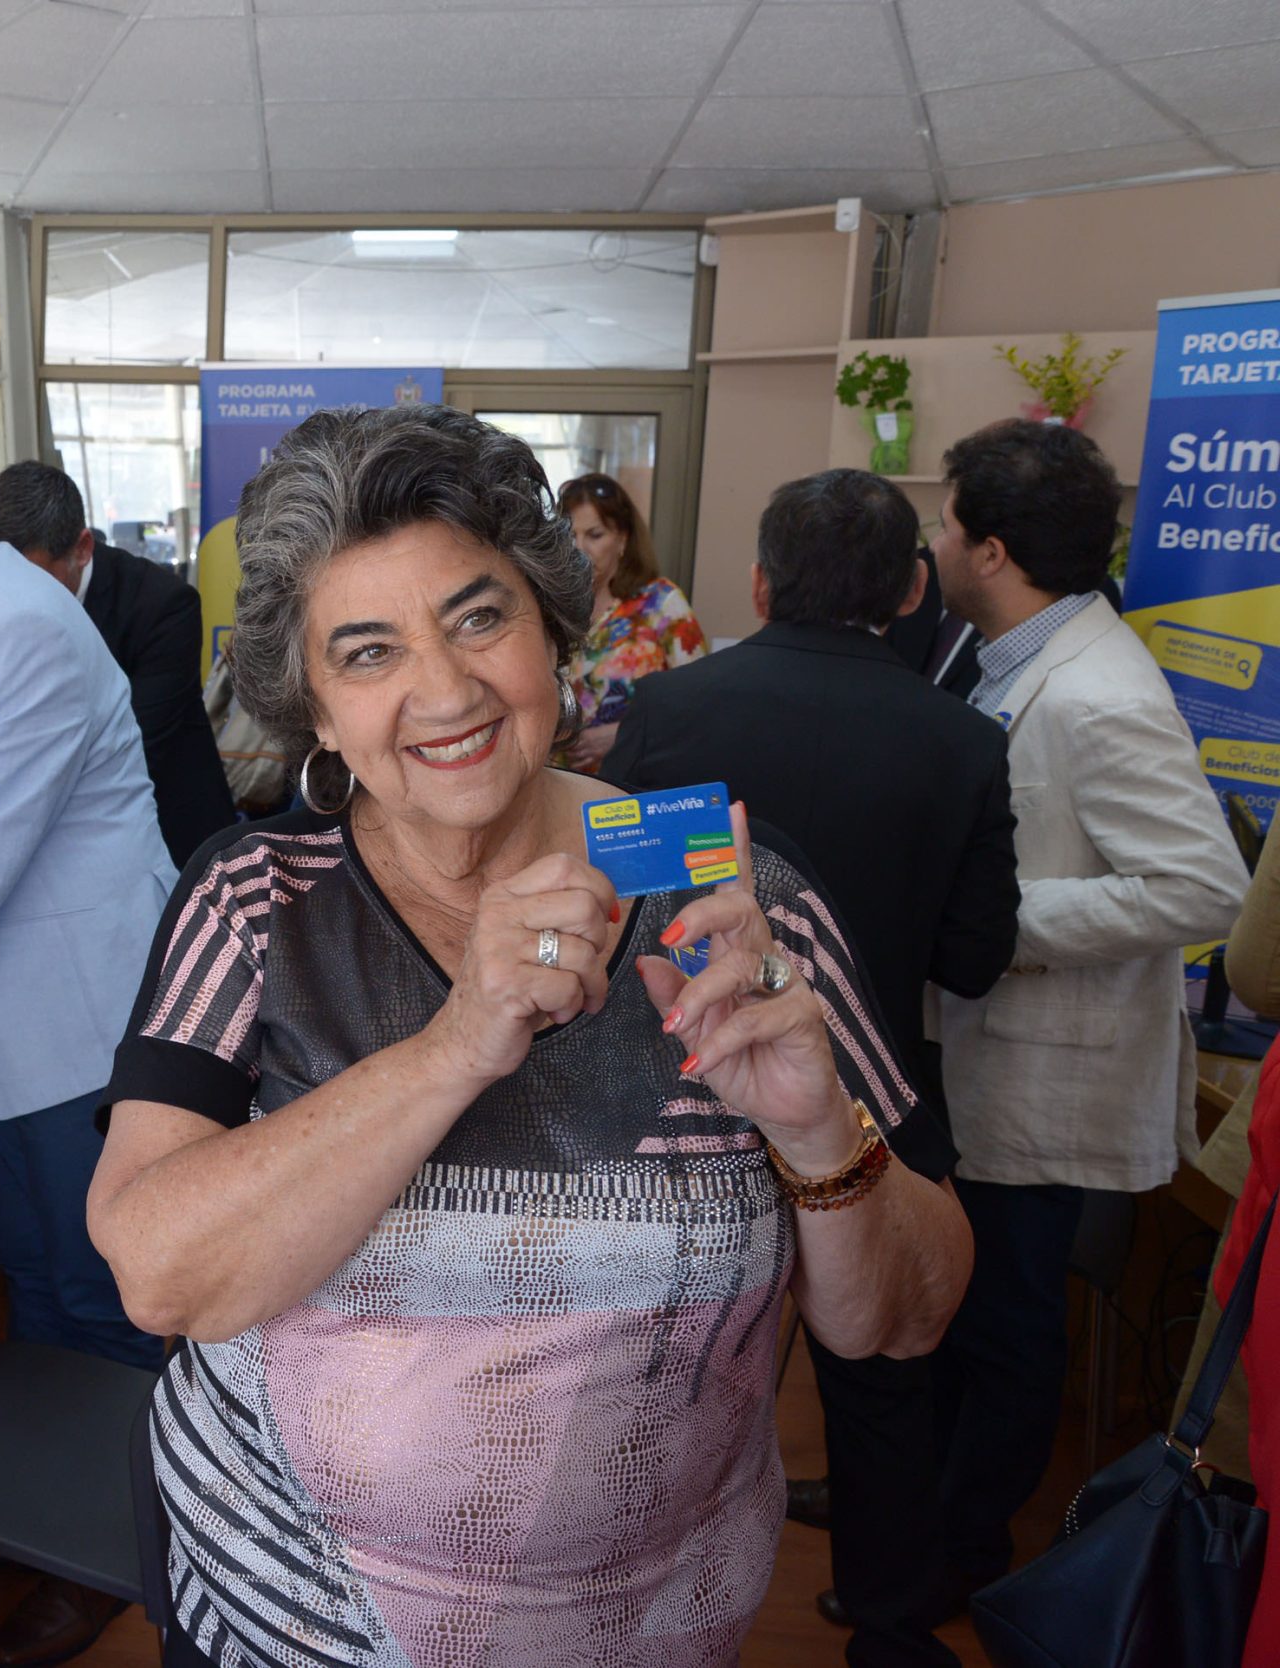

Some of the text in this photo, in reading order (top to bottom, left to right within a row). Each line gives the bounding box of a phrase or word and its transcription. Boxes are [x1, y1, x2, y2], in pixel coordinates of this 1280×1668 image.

[1182, 328, 1280, 355] PROGR
[1179, 360, 1280, 386] TARJET
[218, 384, 316, 398] PROGRAMA
[218, 403, 292, 417] TARJETA
[1162, 483, 1277, 509] Al Club
[604, 805, 624, 814] Club
[646, 798, 704, 816] #ViveViña
[595, 813, 636, 824] Beneficios
